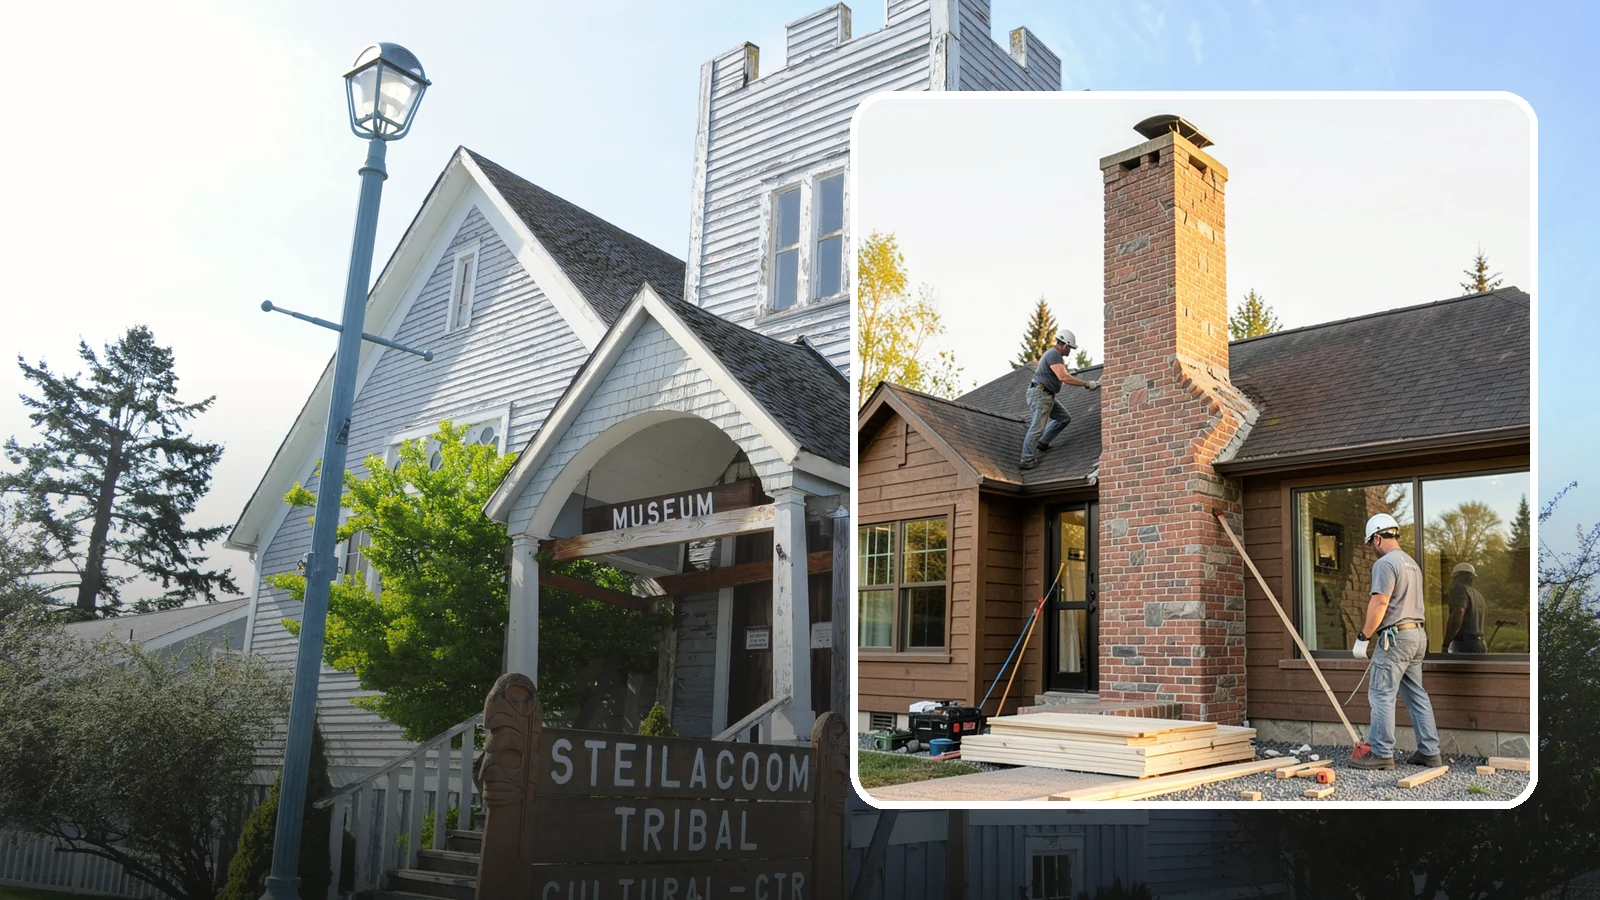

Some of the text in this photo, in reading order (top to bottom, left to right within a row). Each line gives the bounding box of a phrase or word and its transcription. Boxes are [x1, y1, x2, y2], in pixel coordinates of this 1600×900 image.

[612, 491, 714, 531] MUSEUM
[550, 738, 810, 792] STEILACOOM
[614, 806, 758, 852] TRIBAL
